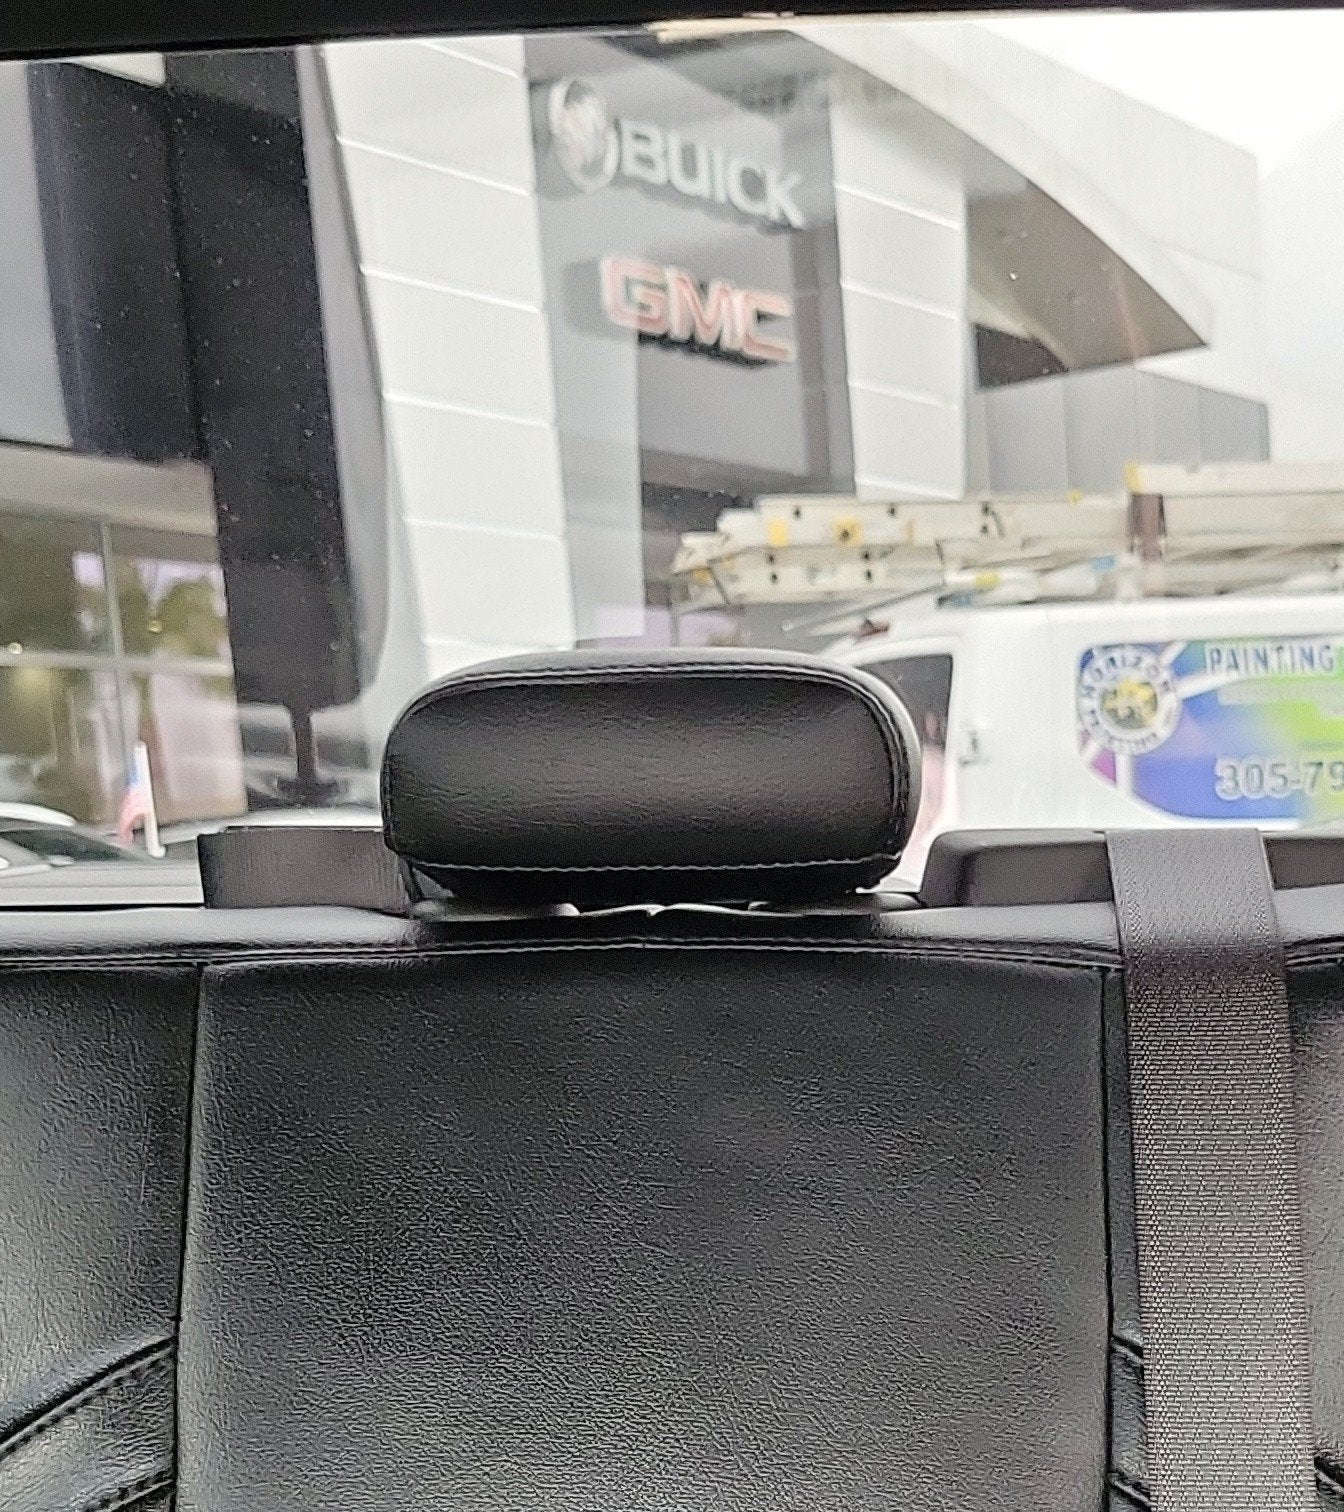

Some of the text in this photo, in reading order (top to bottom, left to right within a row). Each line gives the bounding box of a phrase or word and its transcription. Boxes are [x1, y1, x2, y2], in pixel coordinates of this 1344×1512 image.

[619, 119, 806, 230] BUICK
[600, 255, 796, 362] GMC
[1208, 642, 1336, 675] PAINTING
